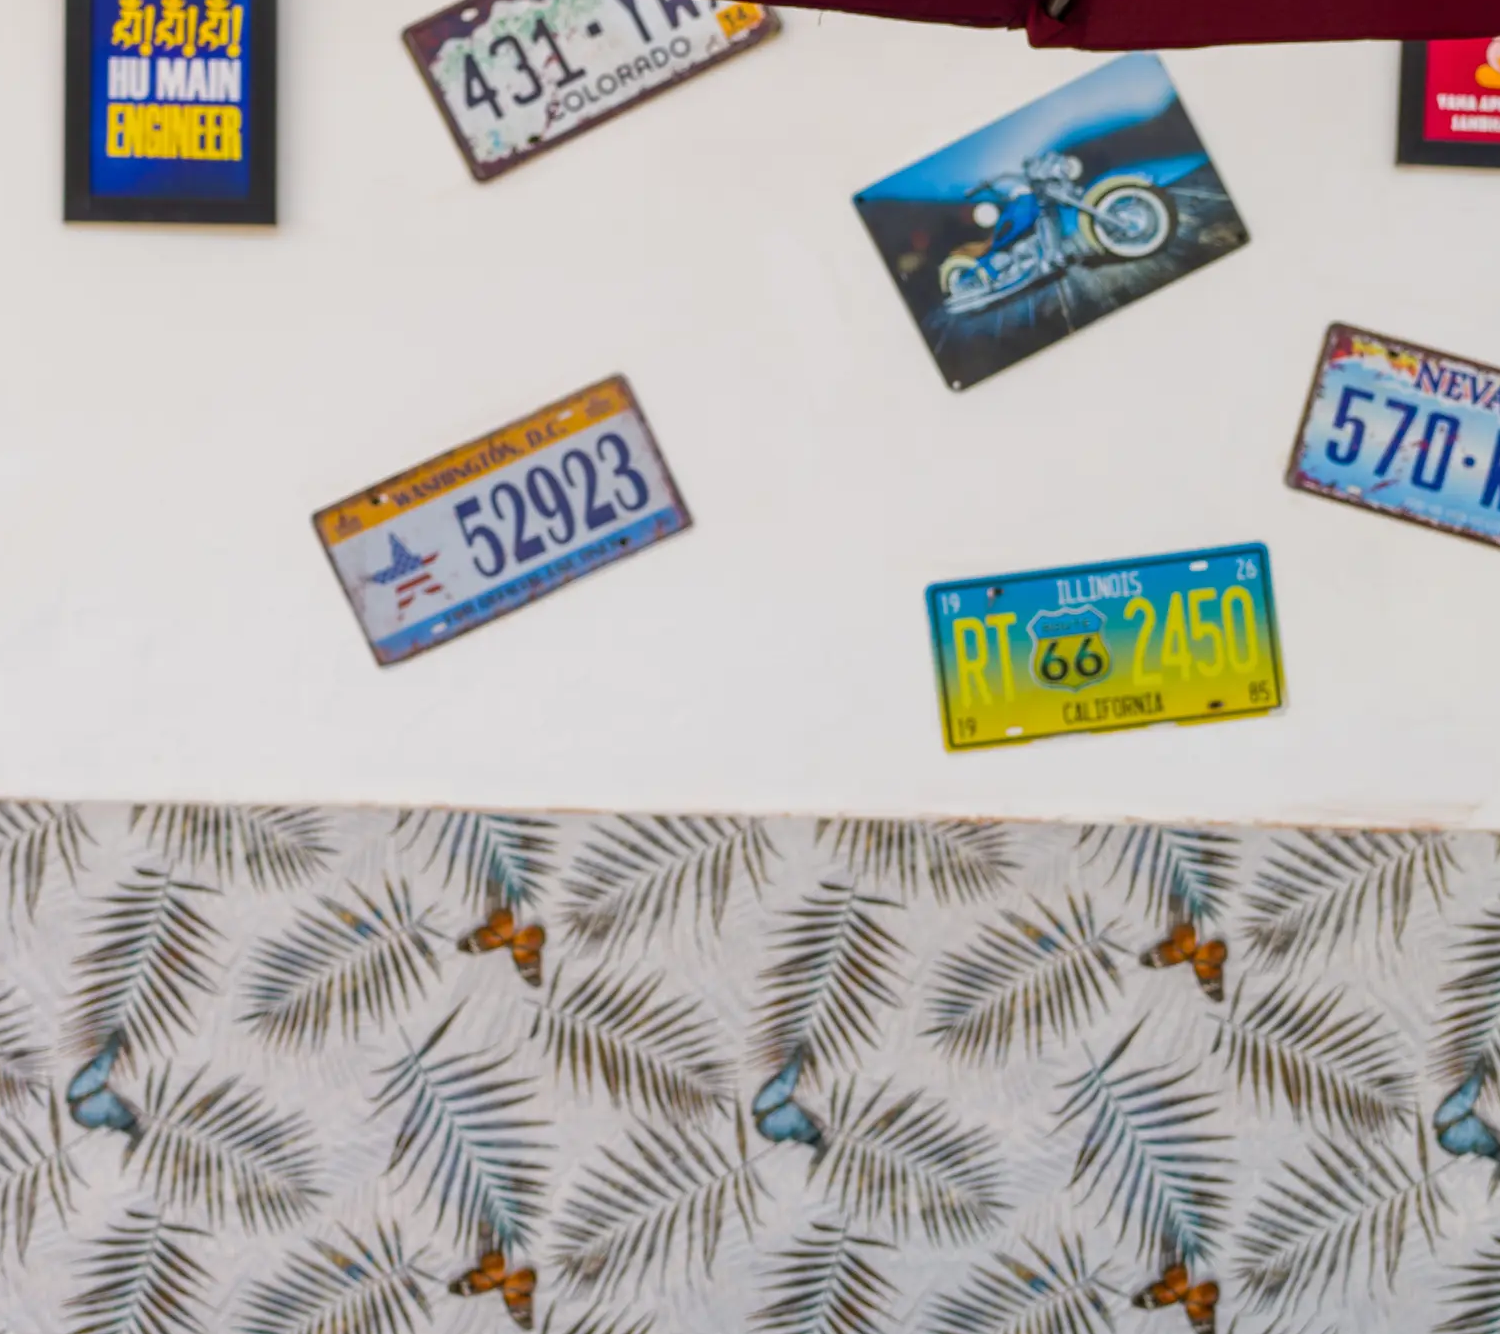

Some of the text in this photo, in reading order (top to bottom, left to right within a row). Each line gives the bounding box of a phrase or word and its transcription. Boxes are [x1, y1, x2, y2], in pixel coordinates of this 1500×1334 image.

[107, 56, 242, 102] HU MAIN
[545, 36, 692, 122] COLORADO
[106, 102, 243, 161] ENGINEER
[453, 431, 650, 579] 52923
[1057, 571, 1143, 606] ILLINOIS
[1236, 558, 1257, 581] 26
[941, 593, 961, 615] 19
[1123, 584, 1259, 687] 2450
[953, 612, 1017, 708] RT
[1039, 636, 1105, 683] 66
[958, 717, 978, 740] 19
[1062, 692, 1165, 726] CALIFORNIA
